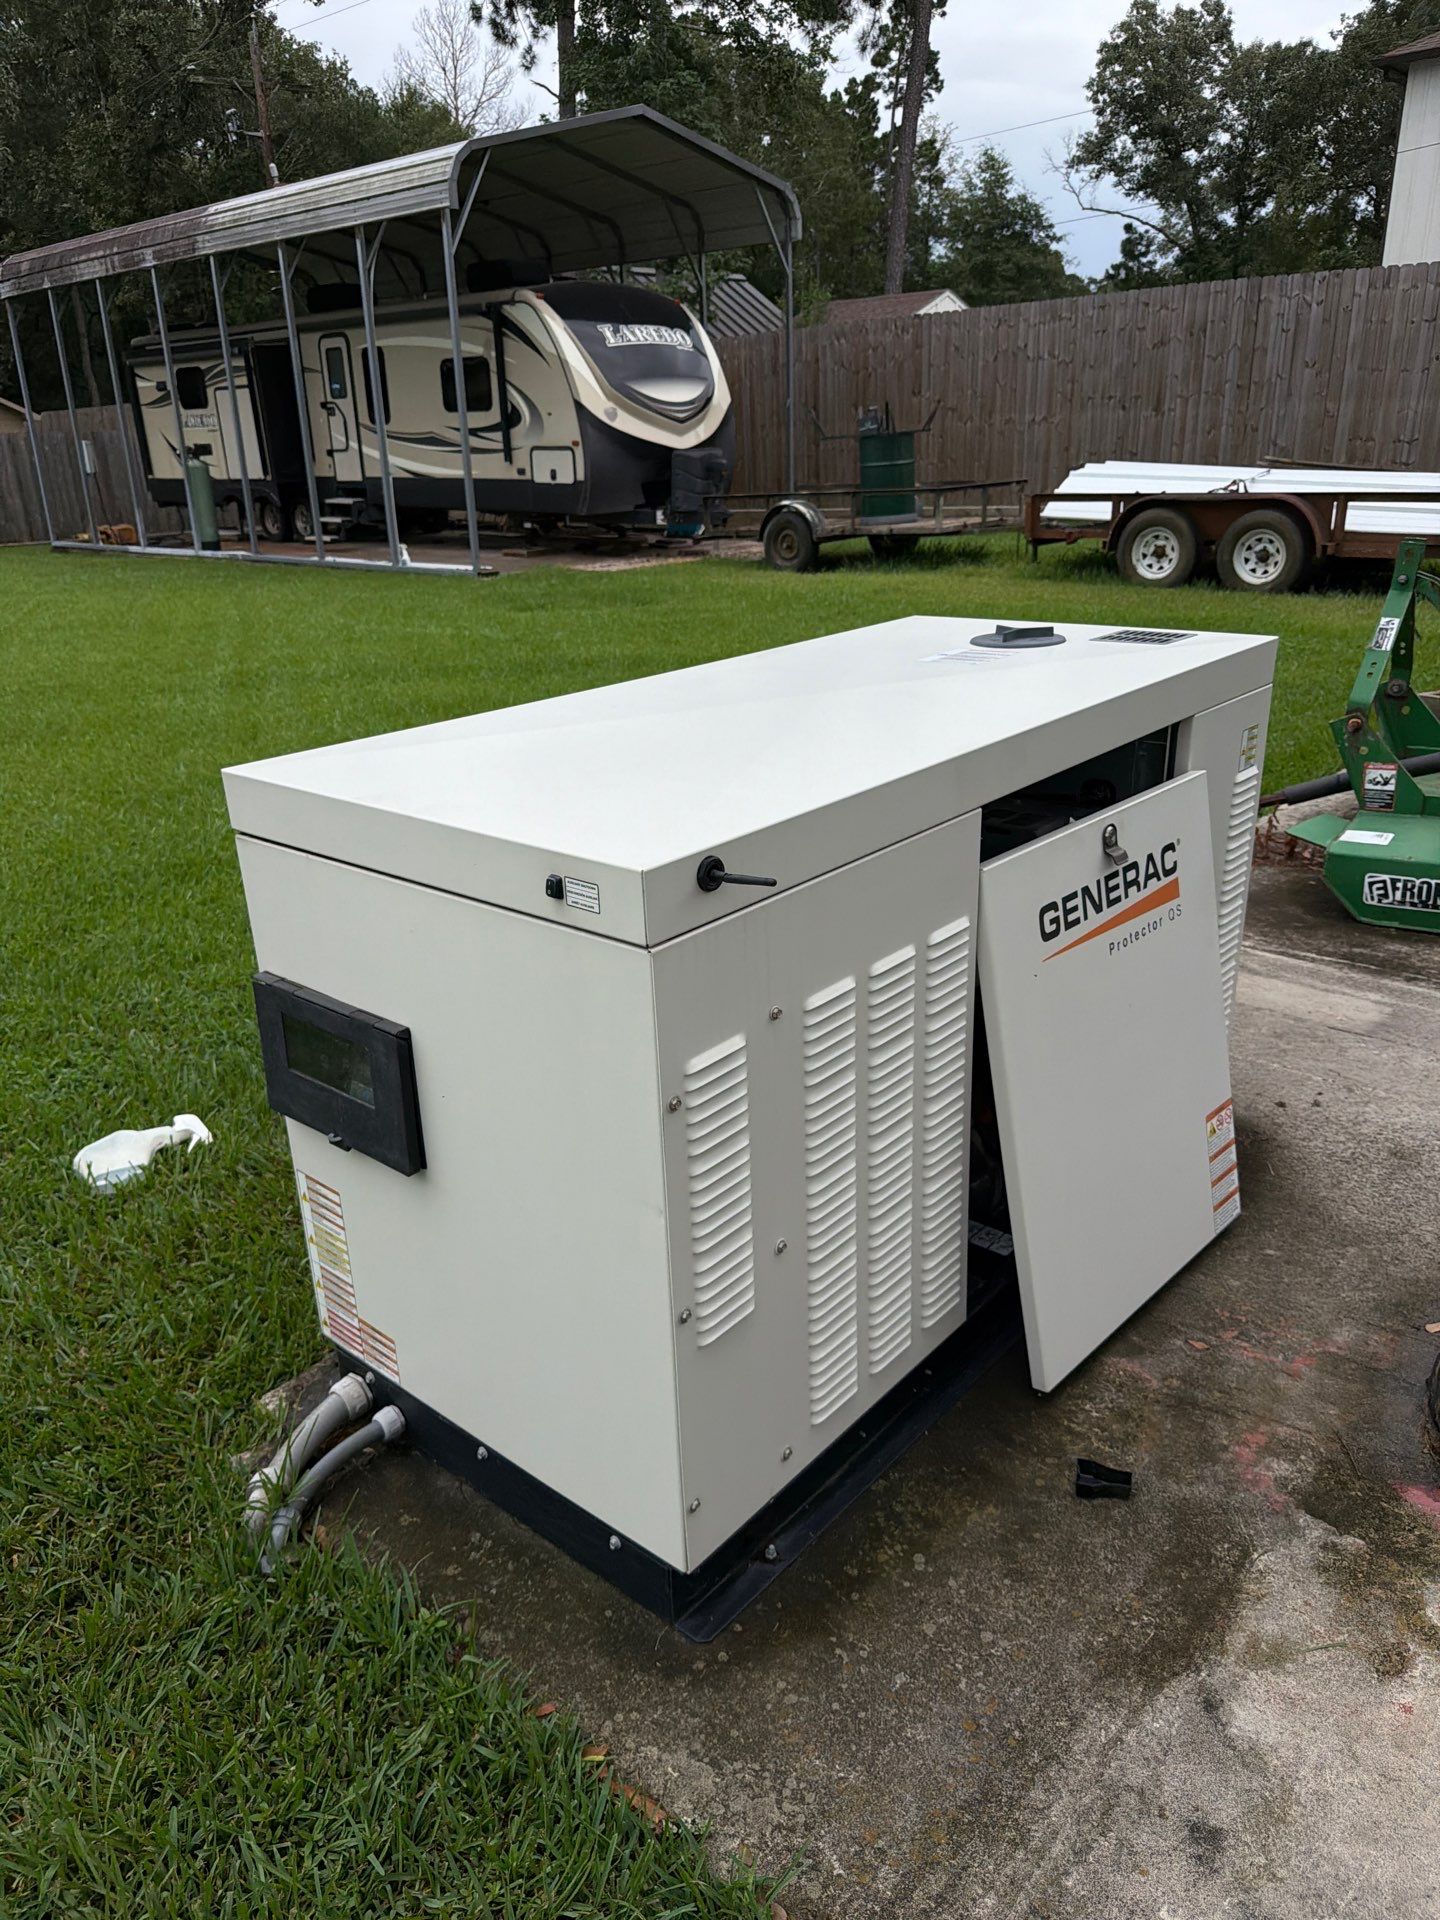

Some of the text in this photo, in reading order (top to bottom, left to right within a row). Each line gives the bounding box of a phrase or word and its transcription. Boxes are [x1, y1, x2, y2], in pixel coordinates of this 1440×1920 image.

[597, 324, 693, 347] LAREDO
[1039, 842, 1178, 942] GENERAC
[1109, 904, 1182, 955] Protector QS
